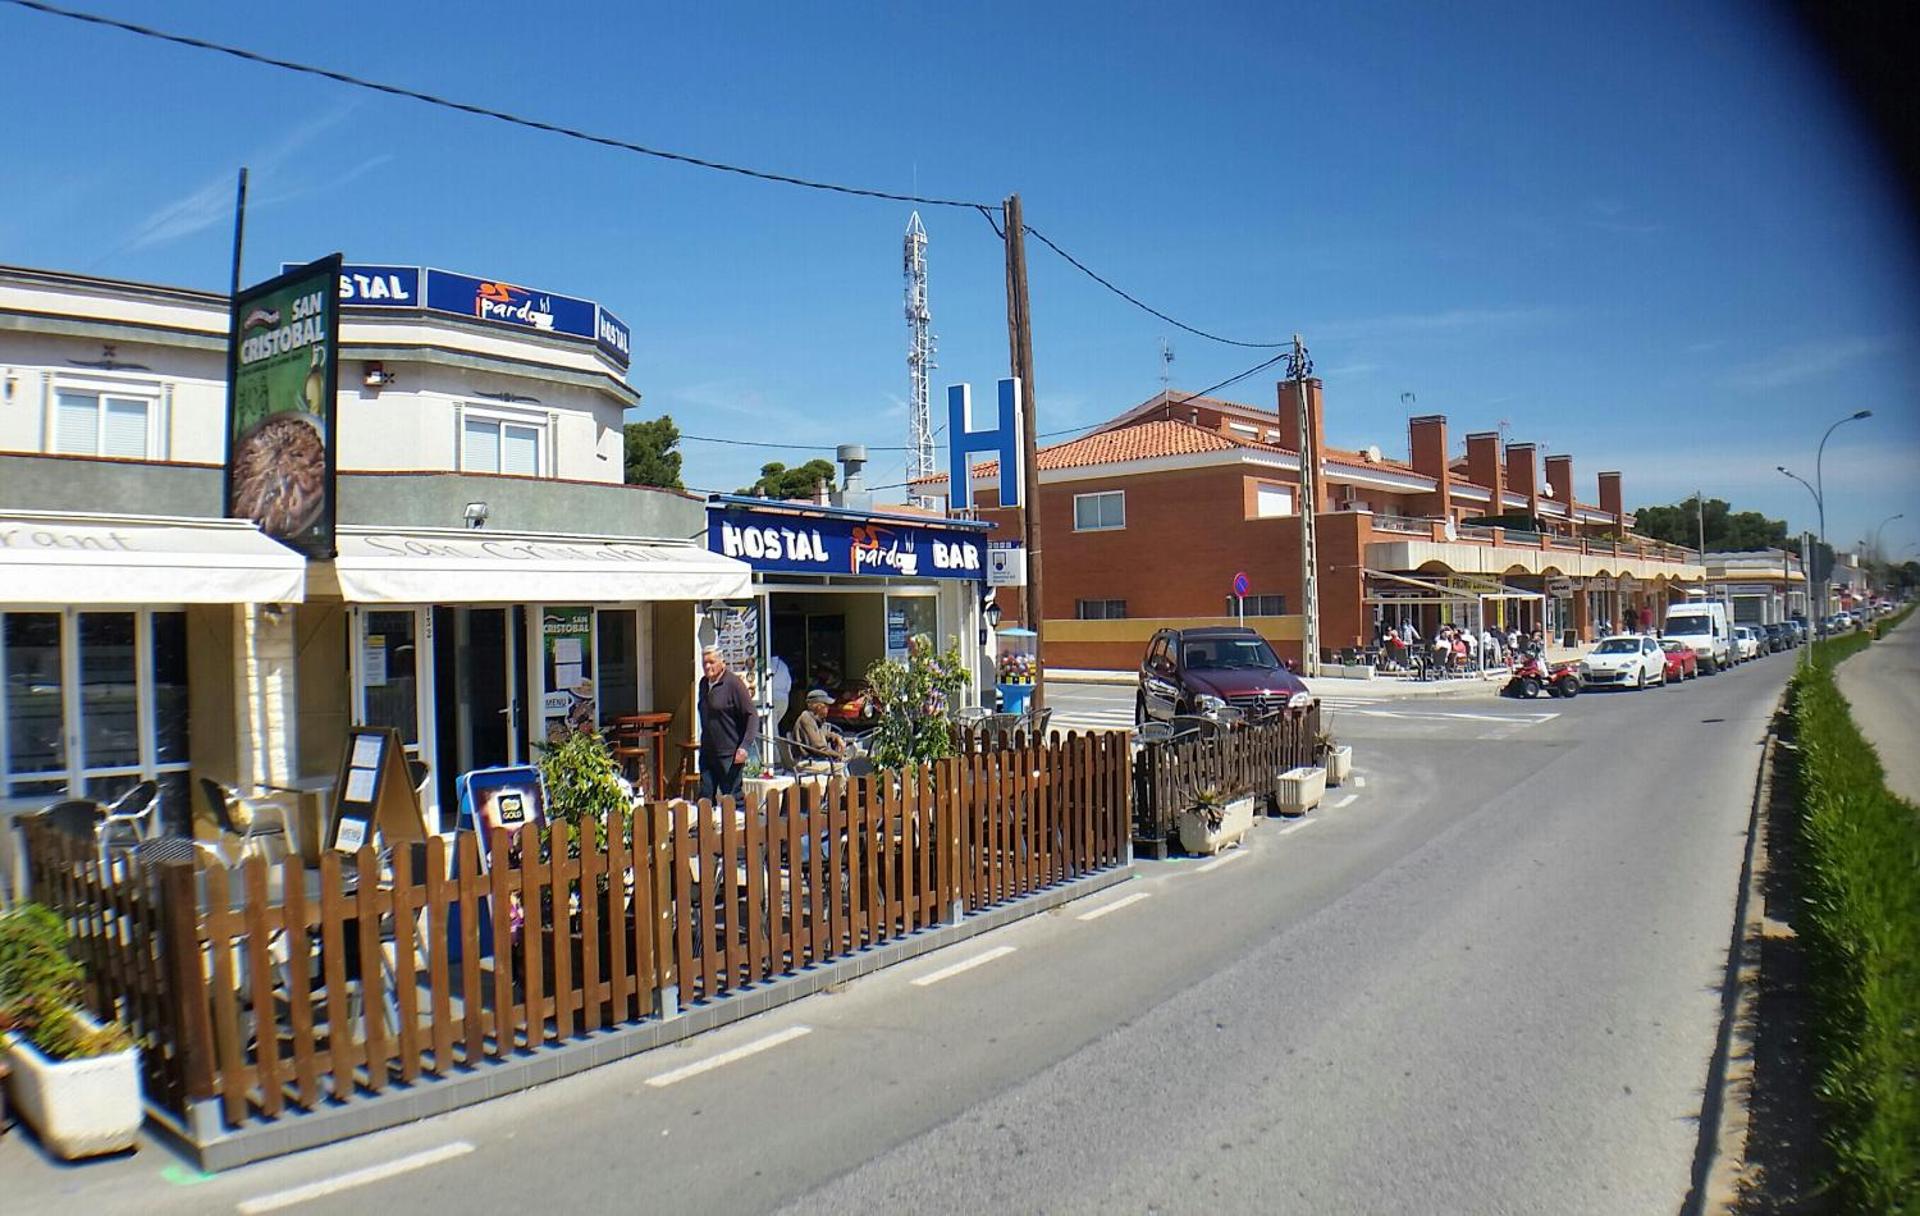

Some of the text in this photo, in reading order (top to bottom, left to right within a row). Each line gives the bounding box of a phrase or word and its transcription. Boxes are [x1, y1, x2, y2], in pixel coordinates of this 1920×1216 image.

[292, 291, 322, 321] SAN
[242, 314, 325, 365] CRISTOBAL
[601, 314, 629, 354] HOSTAL
[947, 377, 1025, 510] H
[722, 520, 829, 562] HOSTAL
[933, 538, 980, 570] BAR
[544, 624, 590, 633] CRISTOBAL
